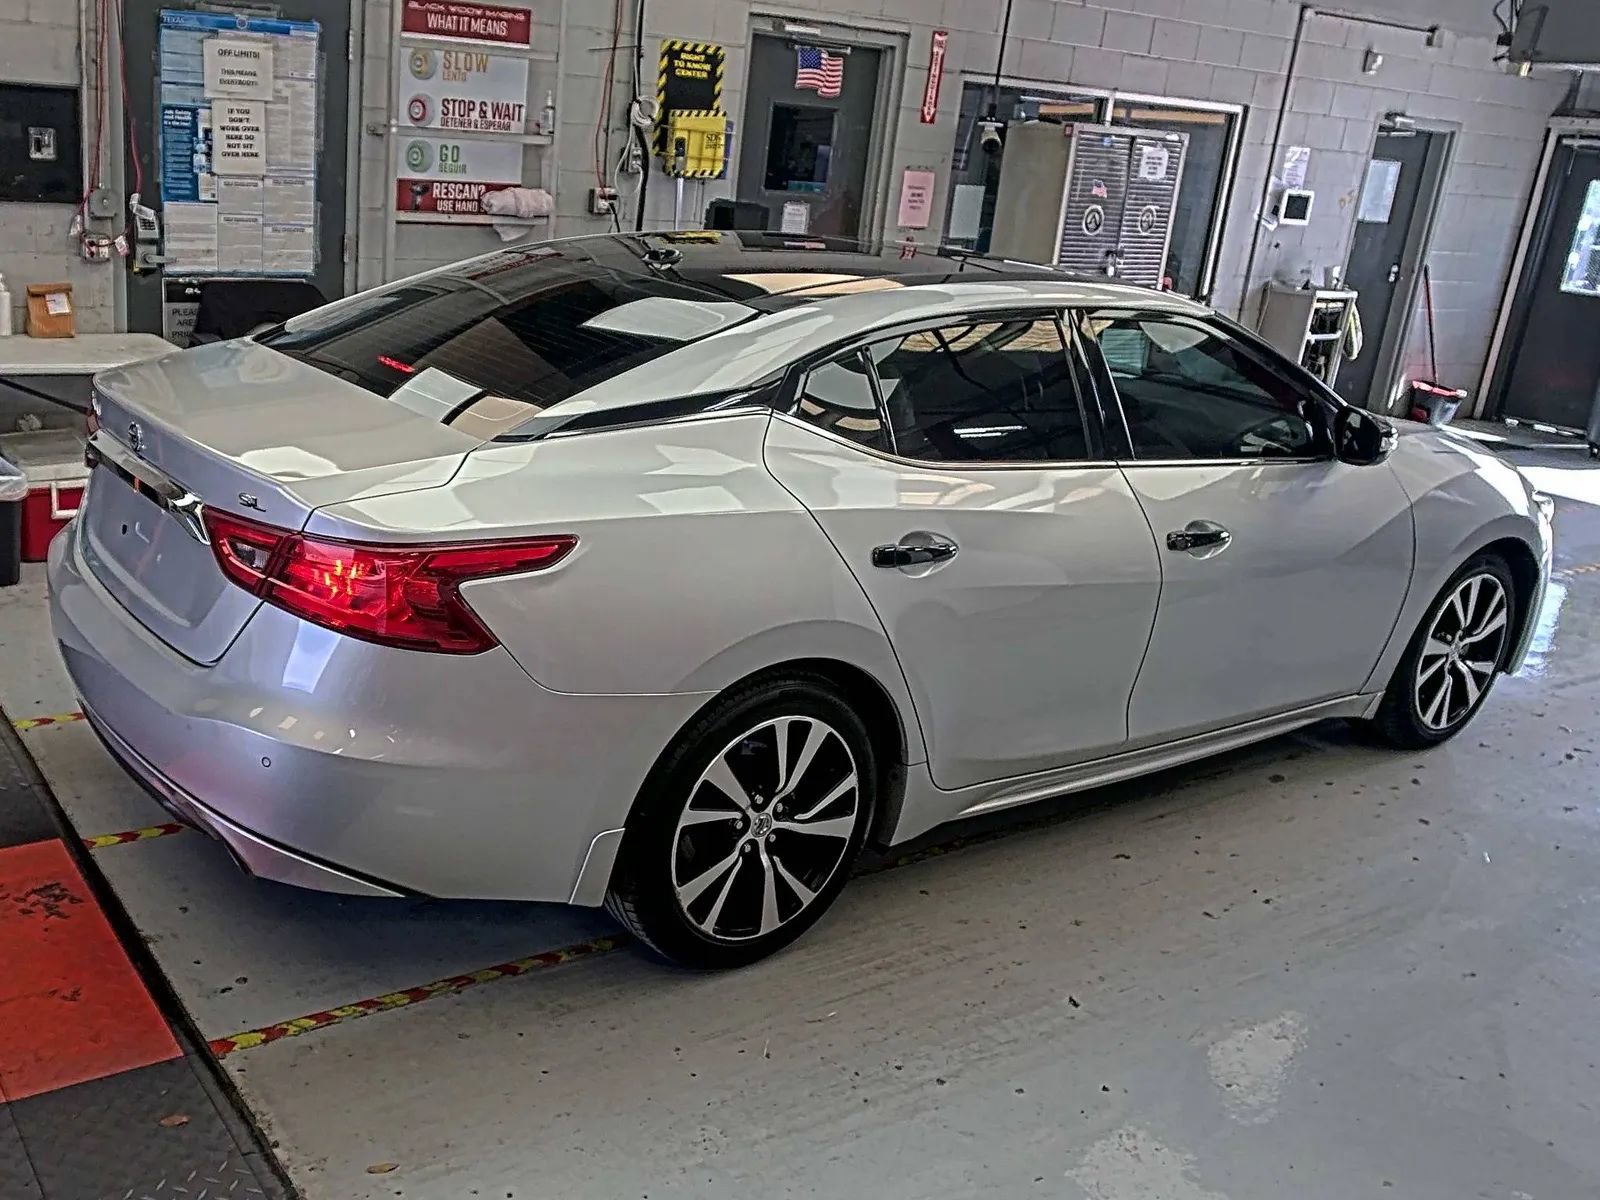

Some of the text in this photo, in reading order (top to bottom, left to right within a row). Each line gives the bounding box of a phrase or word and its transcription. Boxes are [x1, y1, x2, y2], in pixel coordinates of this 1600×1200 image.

[408, 0, 445, 10] BLACK
[427, 12, 508, 36] WHAT IT MEANS
[217, 48, 232, 56] OFF
[442, 50, 489, 73] SLOW
[442, 71, 467, 81] LENTO
[675, 68, 708, 79] CENTER
[228, 107, 250, 115] IF YOU
[440, 98, 524, 122] STOP & WAIT
[219, 125, 260, 133] WORK OVER
[440, 117, 472, 129] DETENER
[480, 121, 512, 132] ESPERAR
[439, 144, 461, 164] GO
[438, 162, 467, 175] SEGUIR
[432, 182, 487, 200] RESCAN?
[437, 200, 454, 212] USE
[455, 200, 479, 212] HAND
[239, 492, 267, 512] SL
